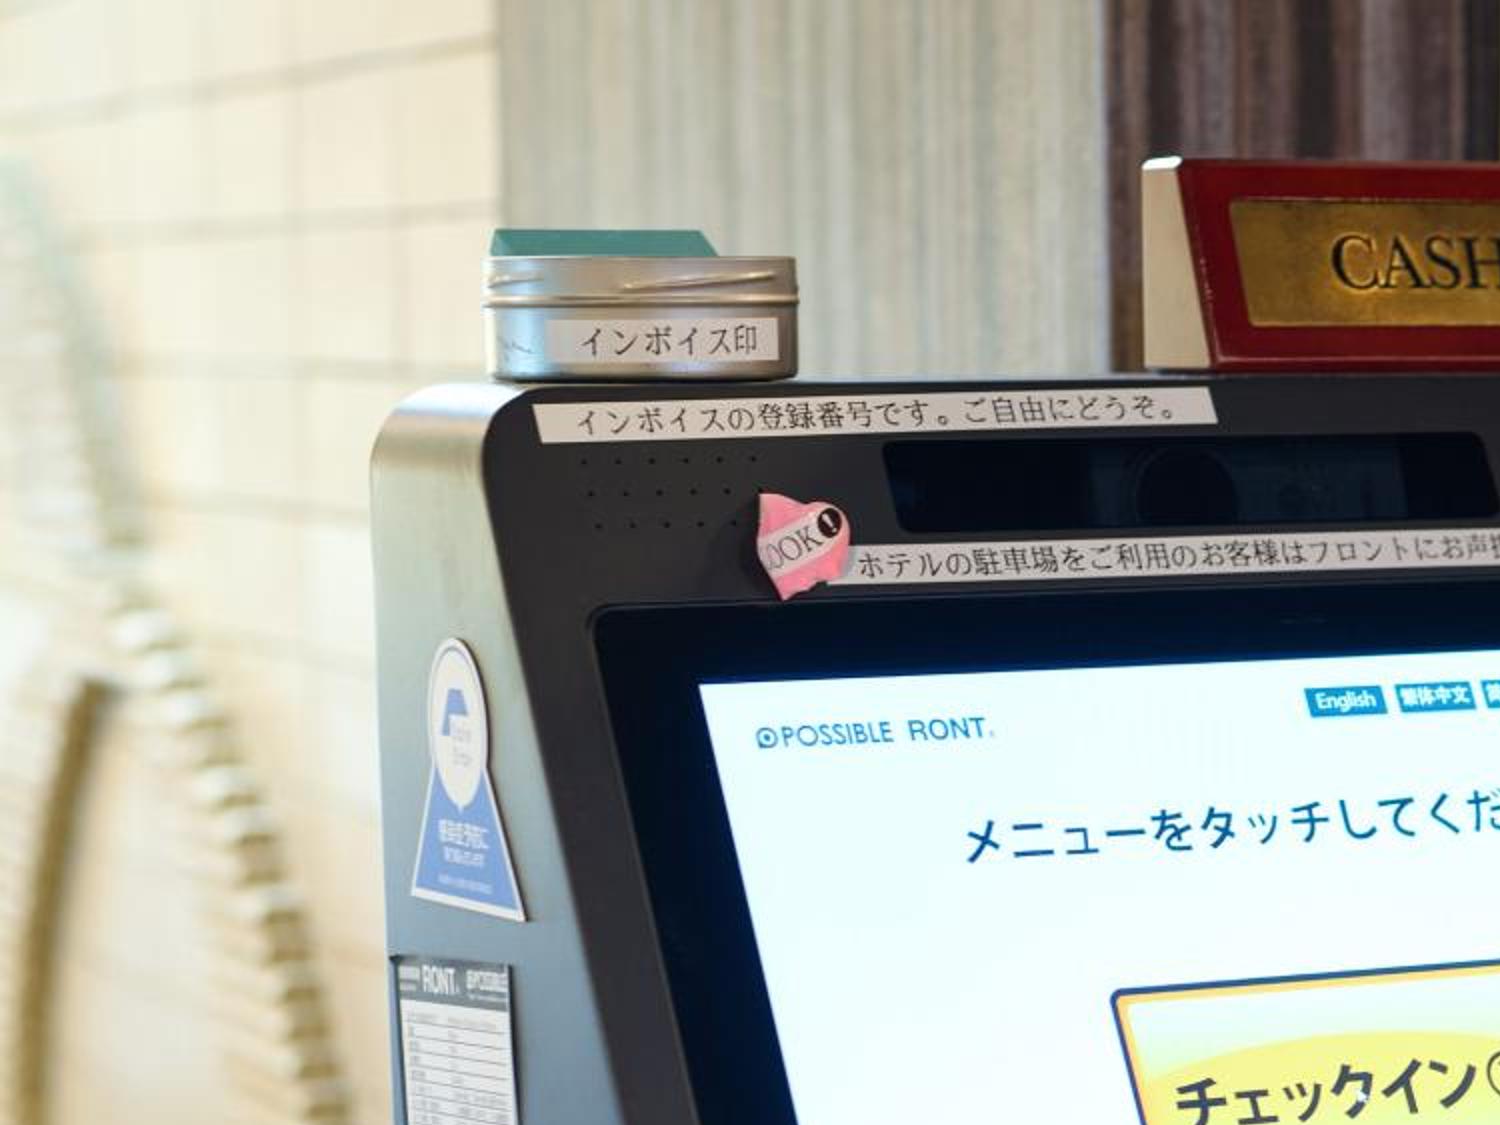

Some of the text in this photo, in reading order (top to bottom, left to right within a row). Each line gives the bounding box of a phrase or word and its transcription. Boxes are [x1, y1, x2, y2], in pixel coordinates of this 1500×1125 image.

[581, 324, 758, 357] インボイス印
[577, 395, 1174, 435] インボイスの登録番号です。ご自由にどうぞ。
[1314, 689, 1377, 713] English
